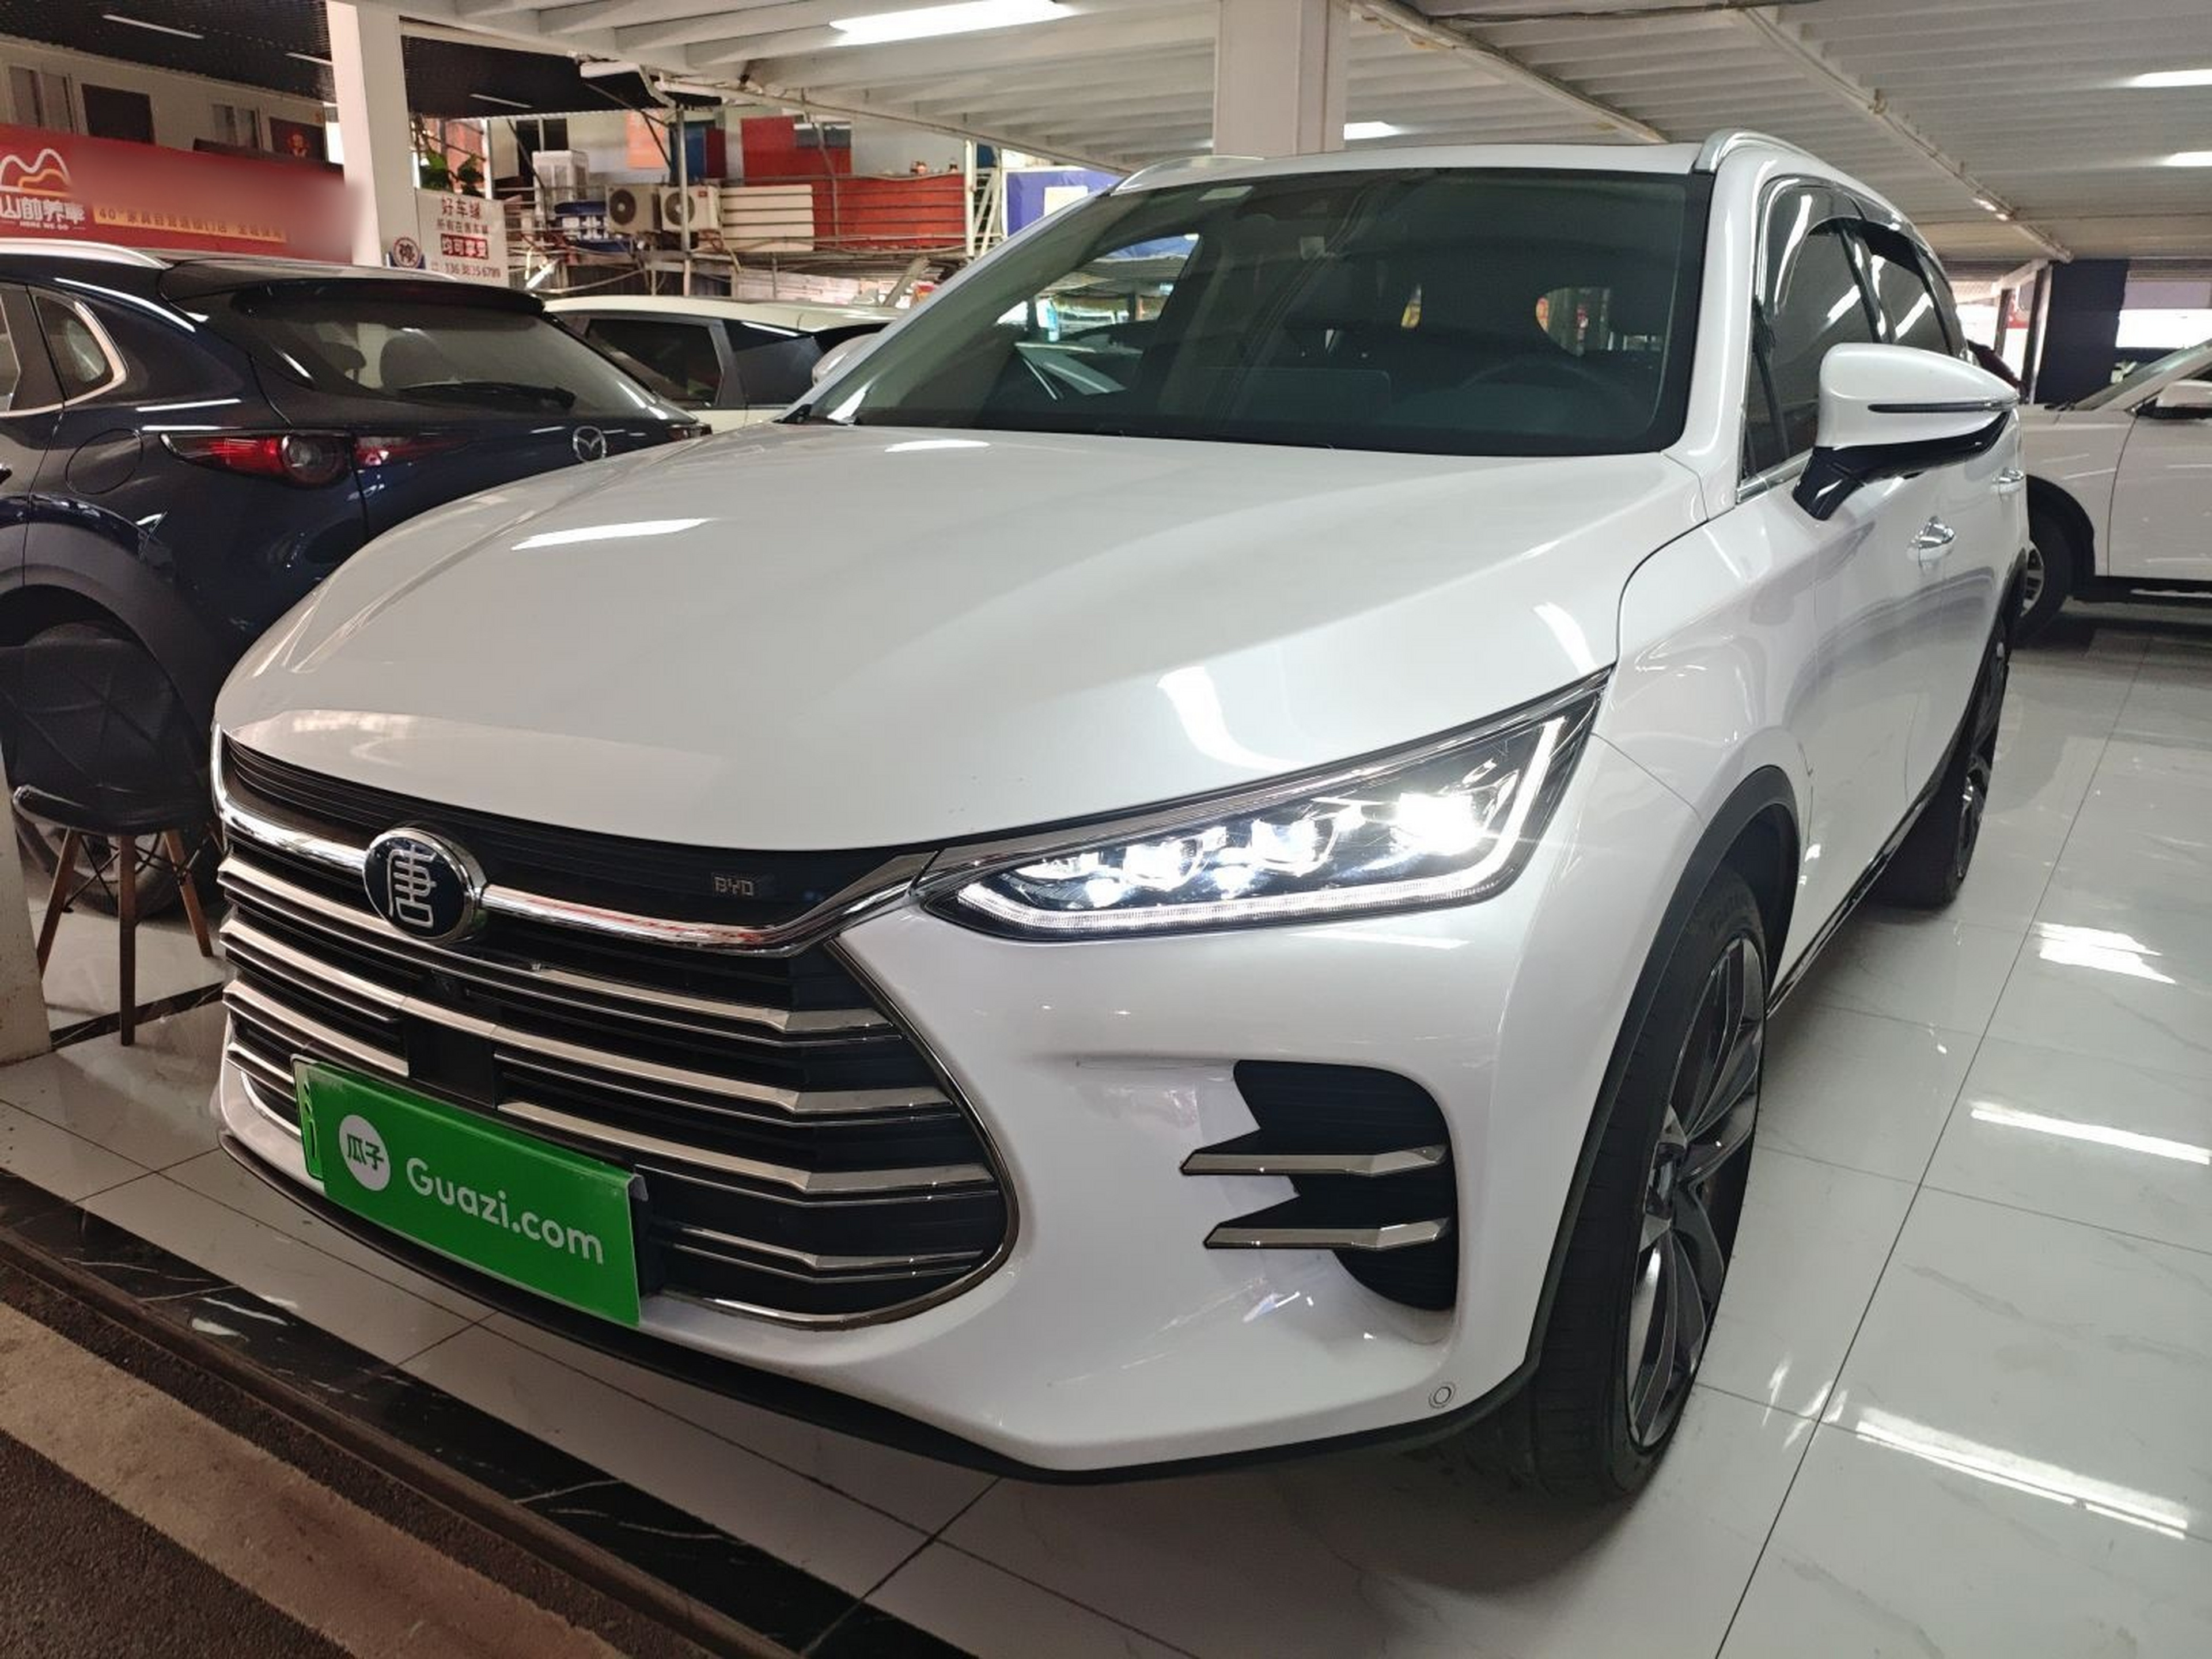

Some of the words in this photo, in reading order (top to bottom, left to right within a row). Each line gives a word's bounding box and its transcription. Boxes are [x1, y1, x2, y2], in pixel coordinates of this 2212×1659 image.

[387, 844, 437, 928] 唐
[714, 877, 753, 896] BYD
[347, 1133, 384, 1171] 瓜子
[407, 1157, 604, 1264] Guazi.com
